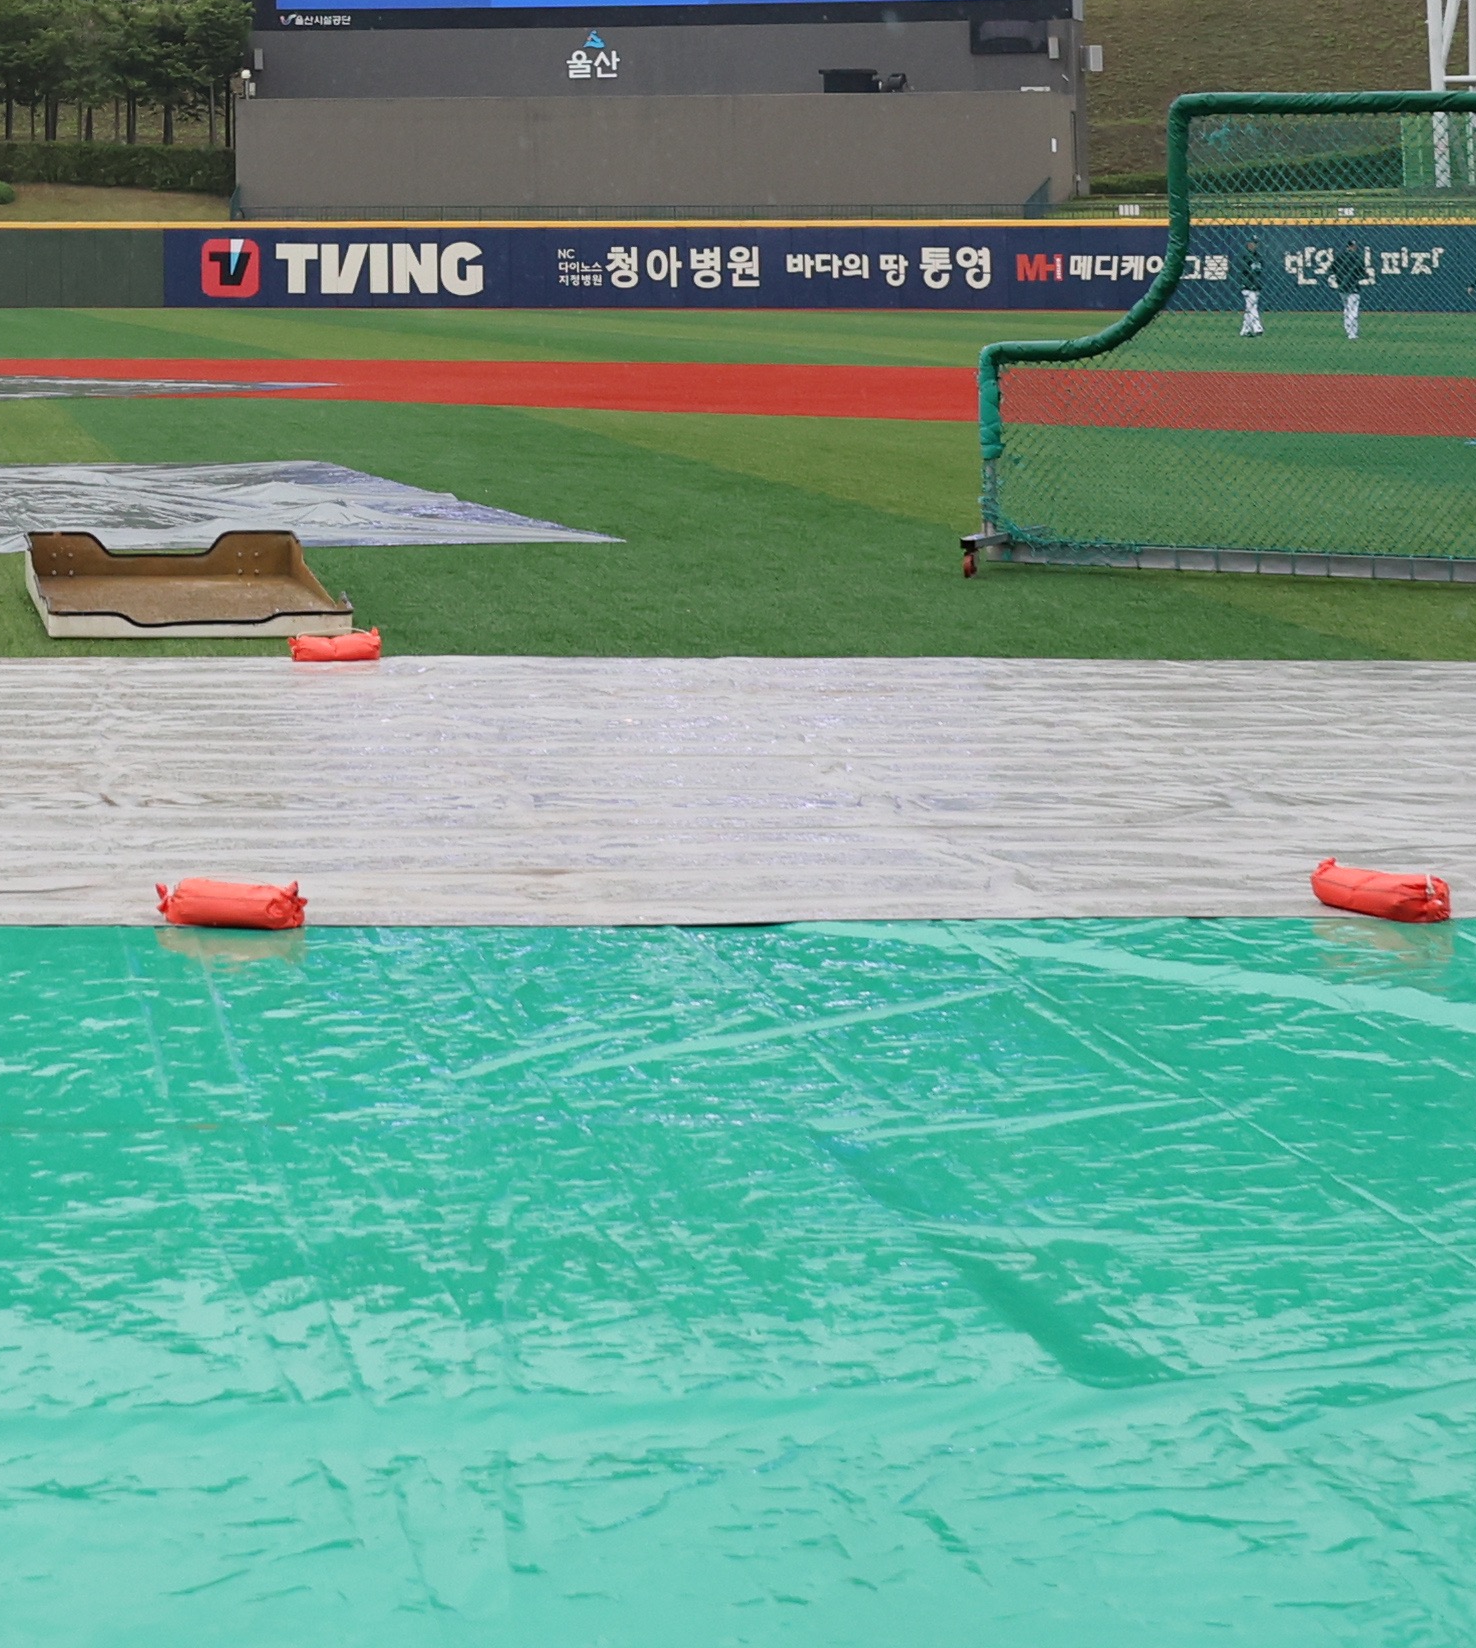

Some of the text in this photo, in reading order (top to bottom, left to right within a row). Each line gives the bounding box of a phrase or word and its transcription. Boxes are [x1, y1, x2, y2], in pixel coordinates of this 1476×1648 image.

[566, 50, 621, 78] 울산
[557, 248, 576, 260] NC
[558, 261, 603, 273] 다이노스
[605, 246, 761, 289] 청아병원
[786, 246, 992, 289] 바다의 땅 통영
[275, 241, 484, 296] TVING
[558, 274, 603, 287] 지정병원
